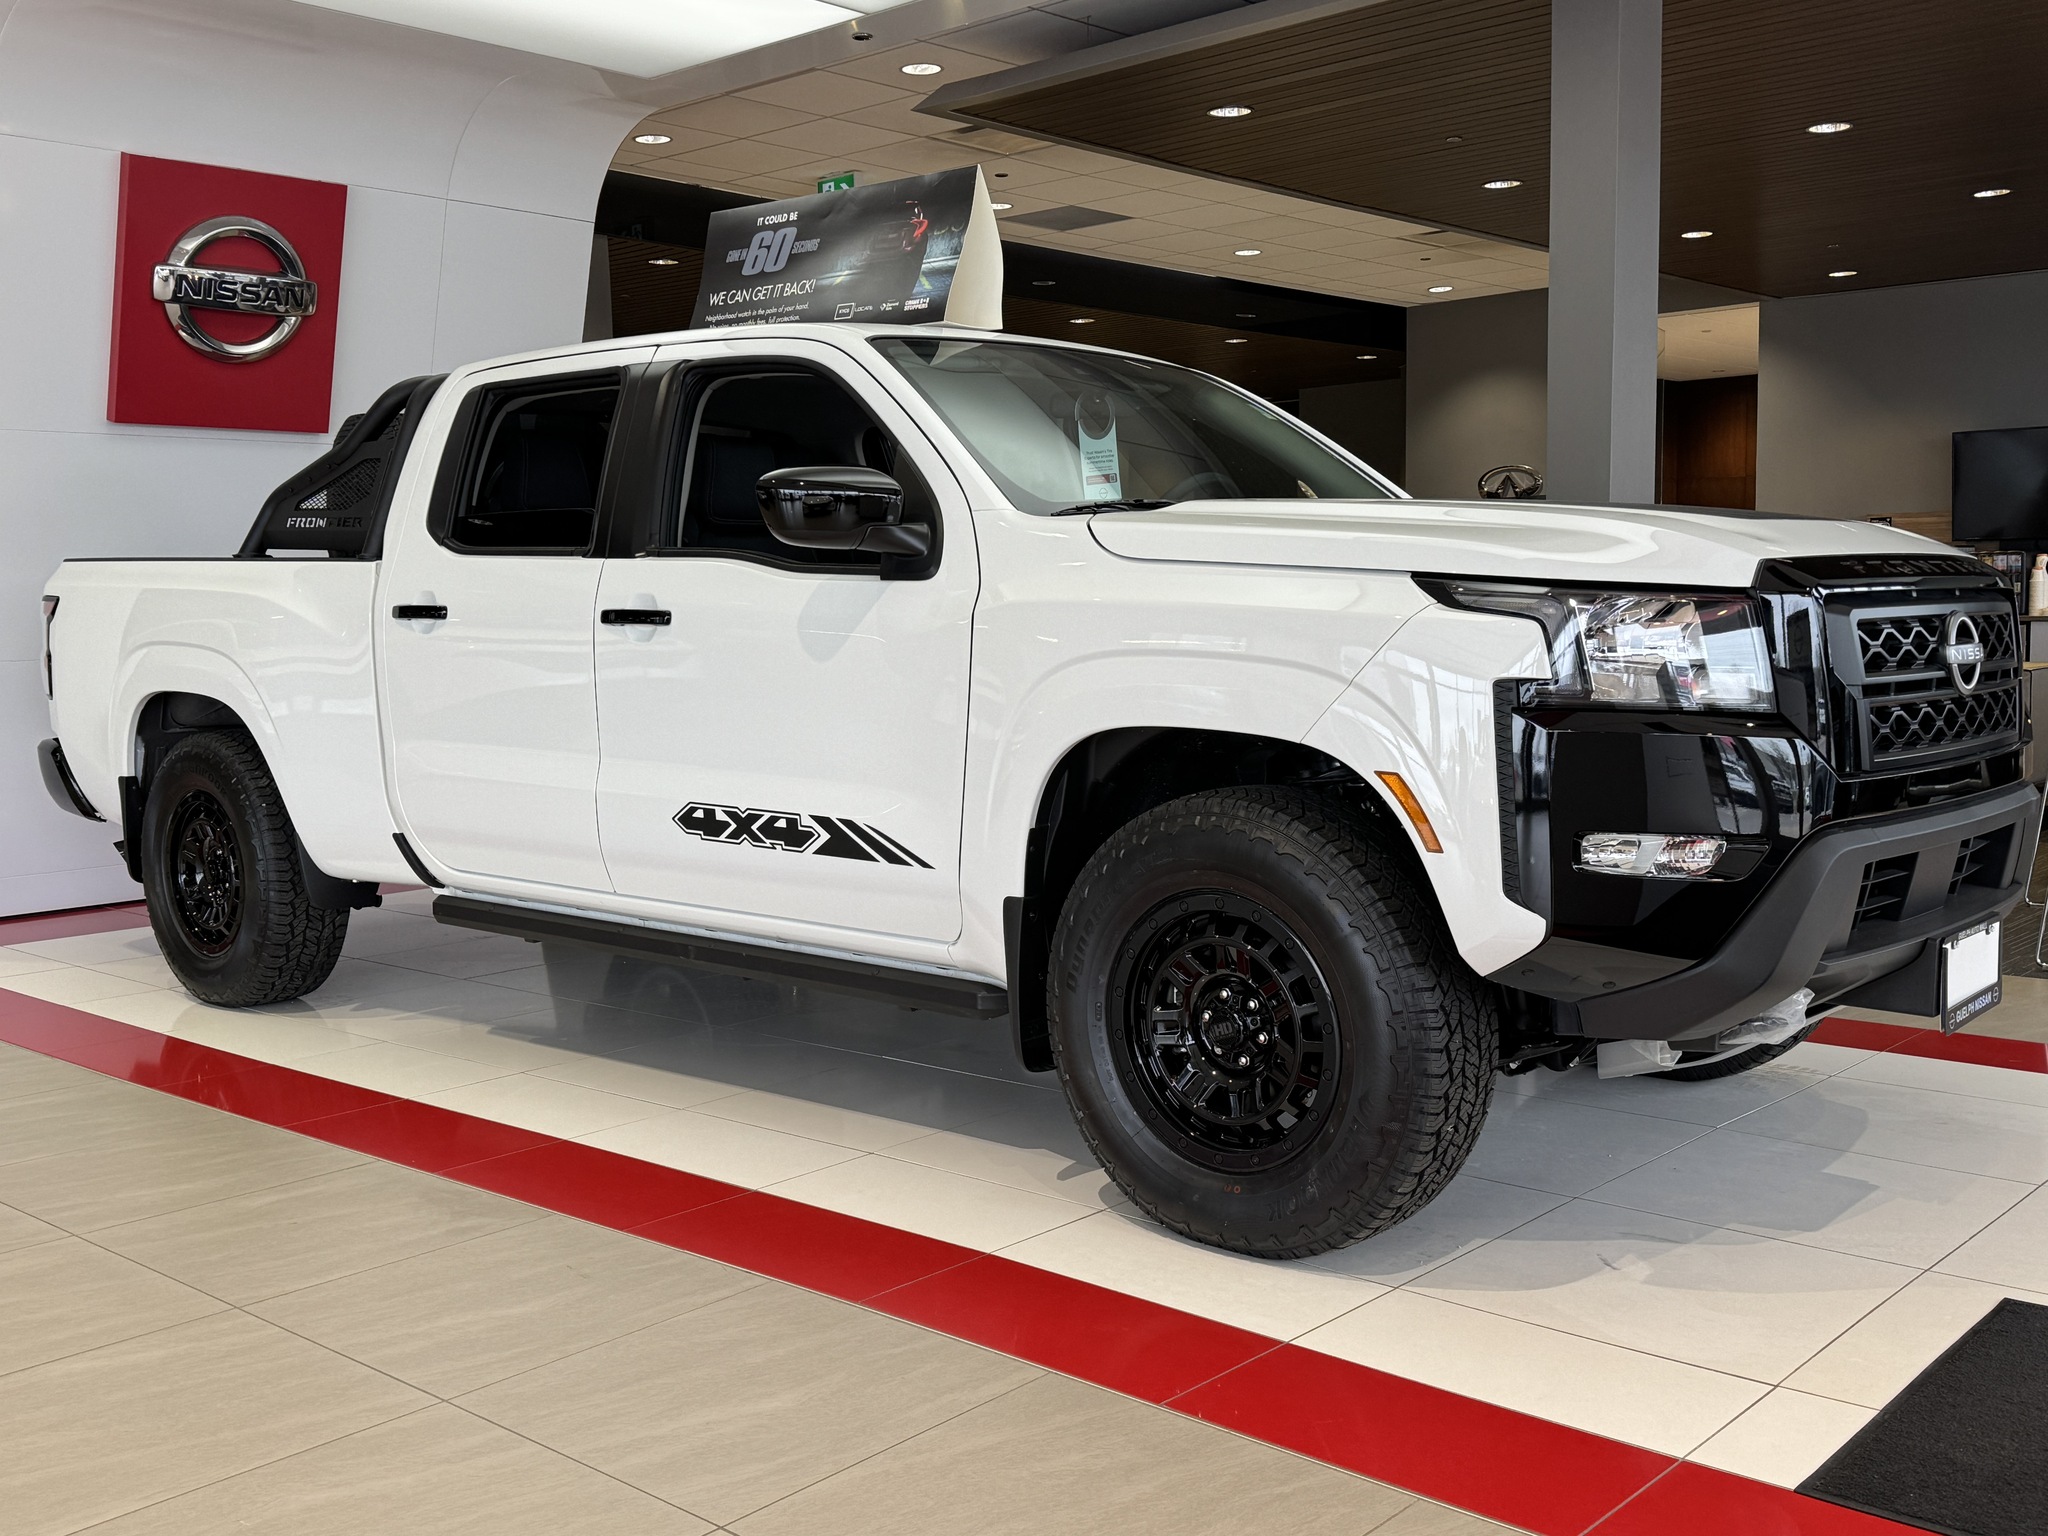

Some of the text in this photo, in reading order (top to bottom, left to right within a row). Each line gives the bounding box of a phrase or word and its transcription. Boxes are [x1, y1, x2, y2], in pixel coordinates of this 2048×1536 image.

[757, 211, 798, 226] IT COULD BE
[741, 226, 798, 276] 60
[791, 238, 820, 254] SECONDS
[176, 273, 305, 308] NISSAN
[709, 279, 817, 307] WE CAN GET IT BACK!
[286, 517, 363, 528] FRONTIER
[673, 802, 820, 853] 4X4
[1956, 991, 1992, 1023] GUELPH NISSAN
